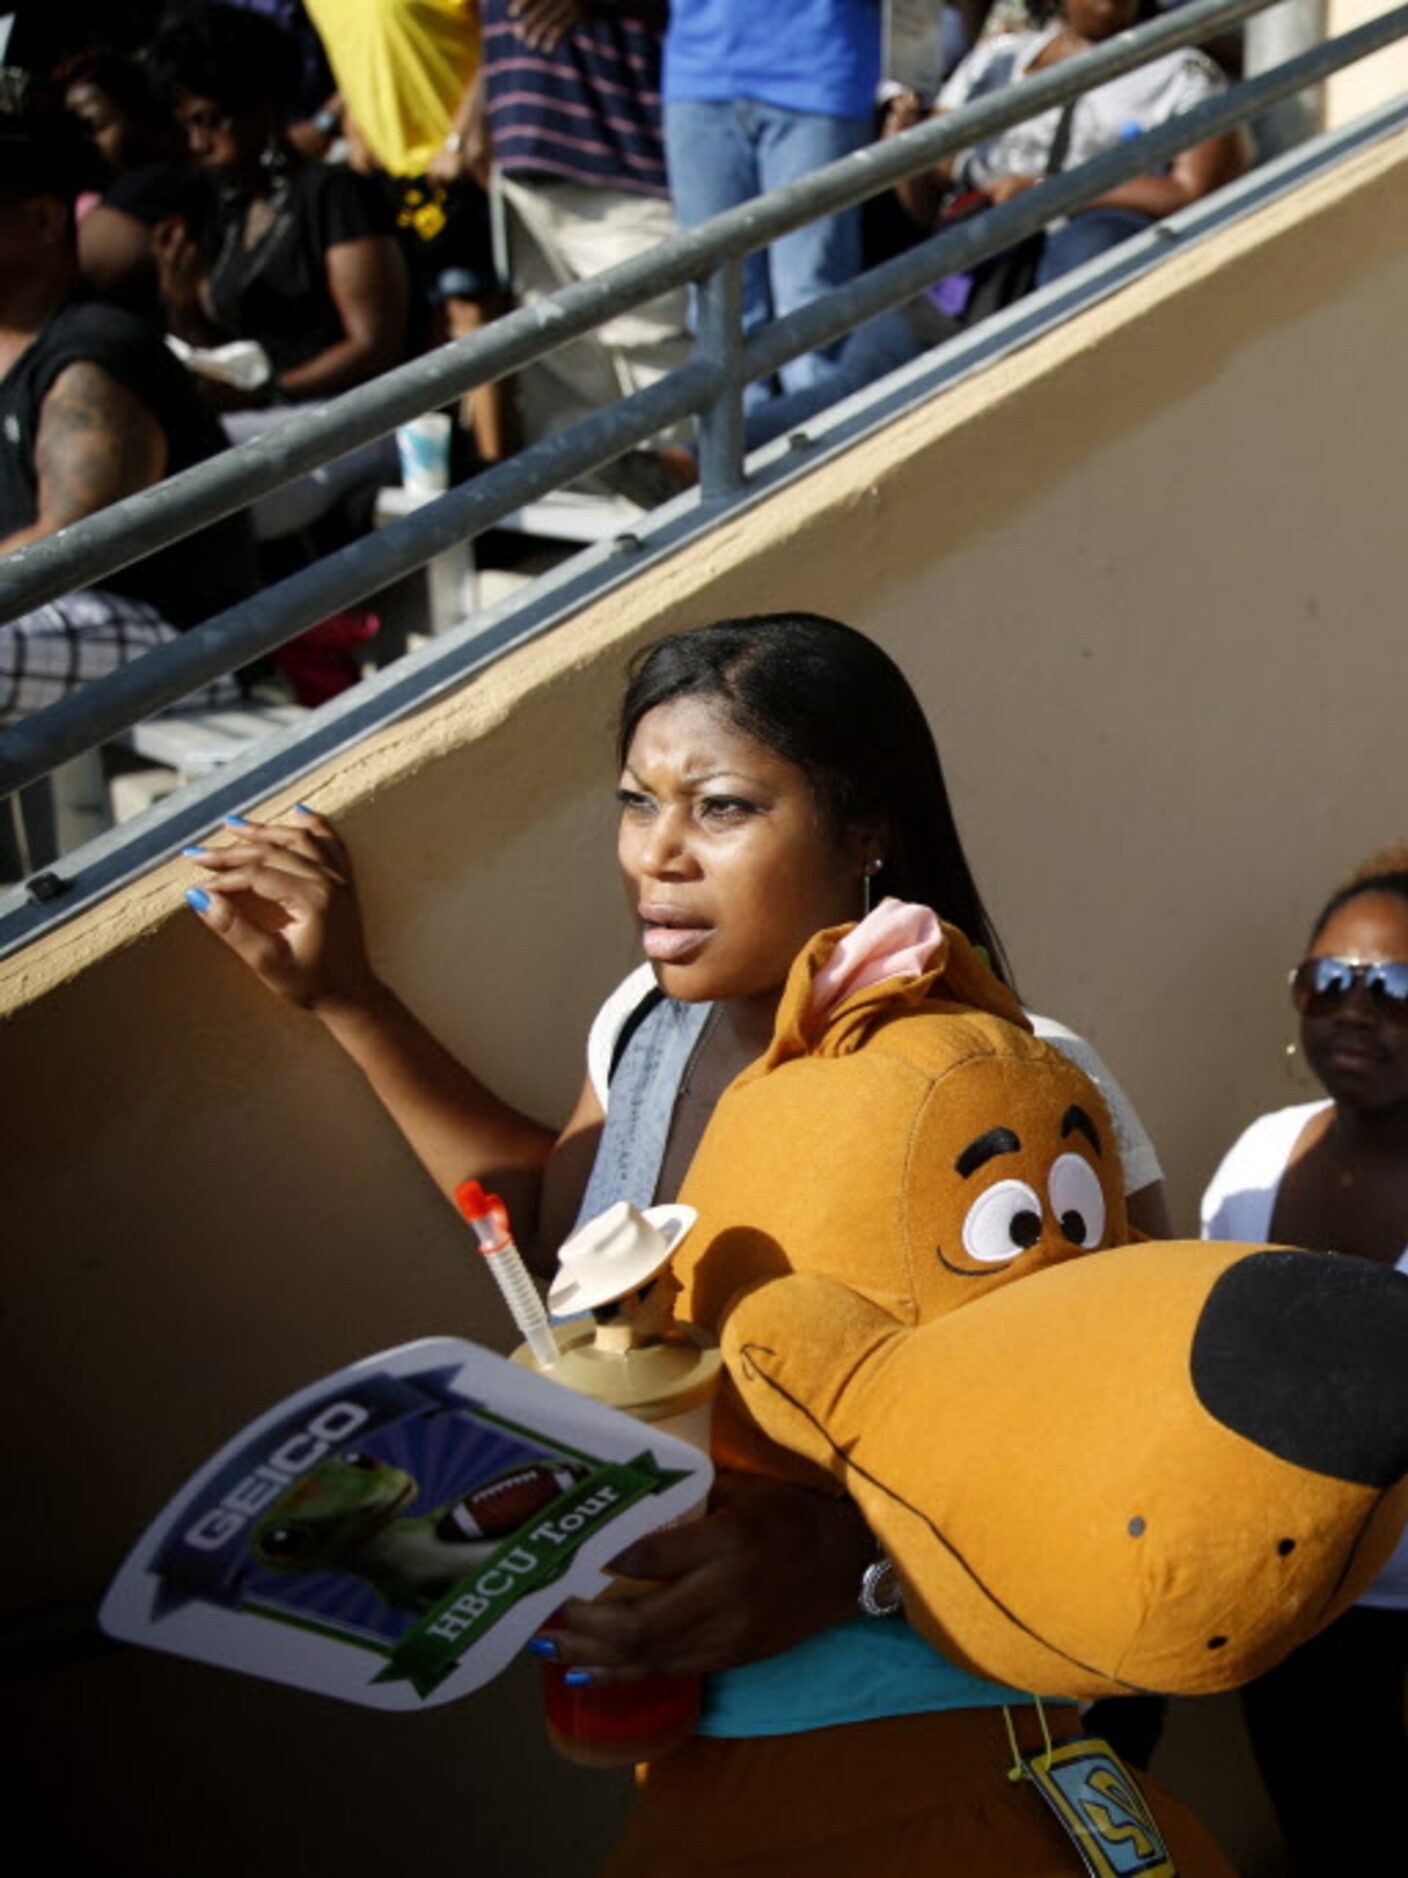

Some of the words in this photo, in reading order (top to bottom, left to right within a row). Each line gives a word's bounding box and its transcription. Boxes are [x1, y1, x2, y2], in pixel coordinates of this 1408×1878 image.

[184, 1401, 369, 1551] GEICO
[426, 1548, 539, 1645] HBCU
[532, 1484, 621, 1563] Tour
